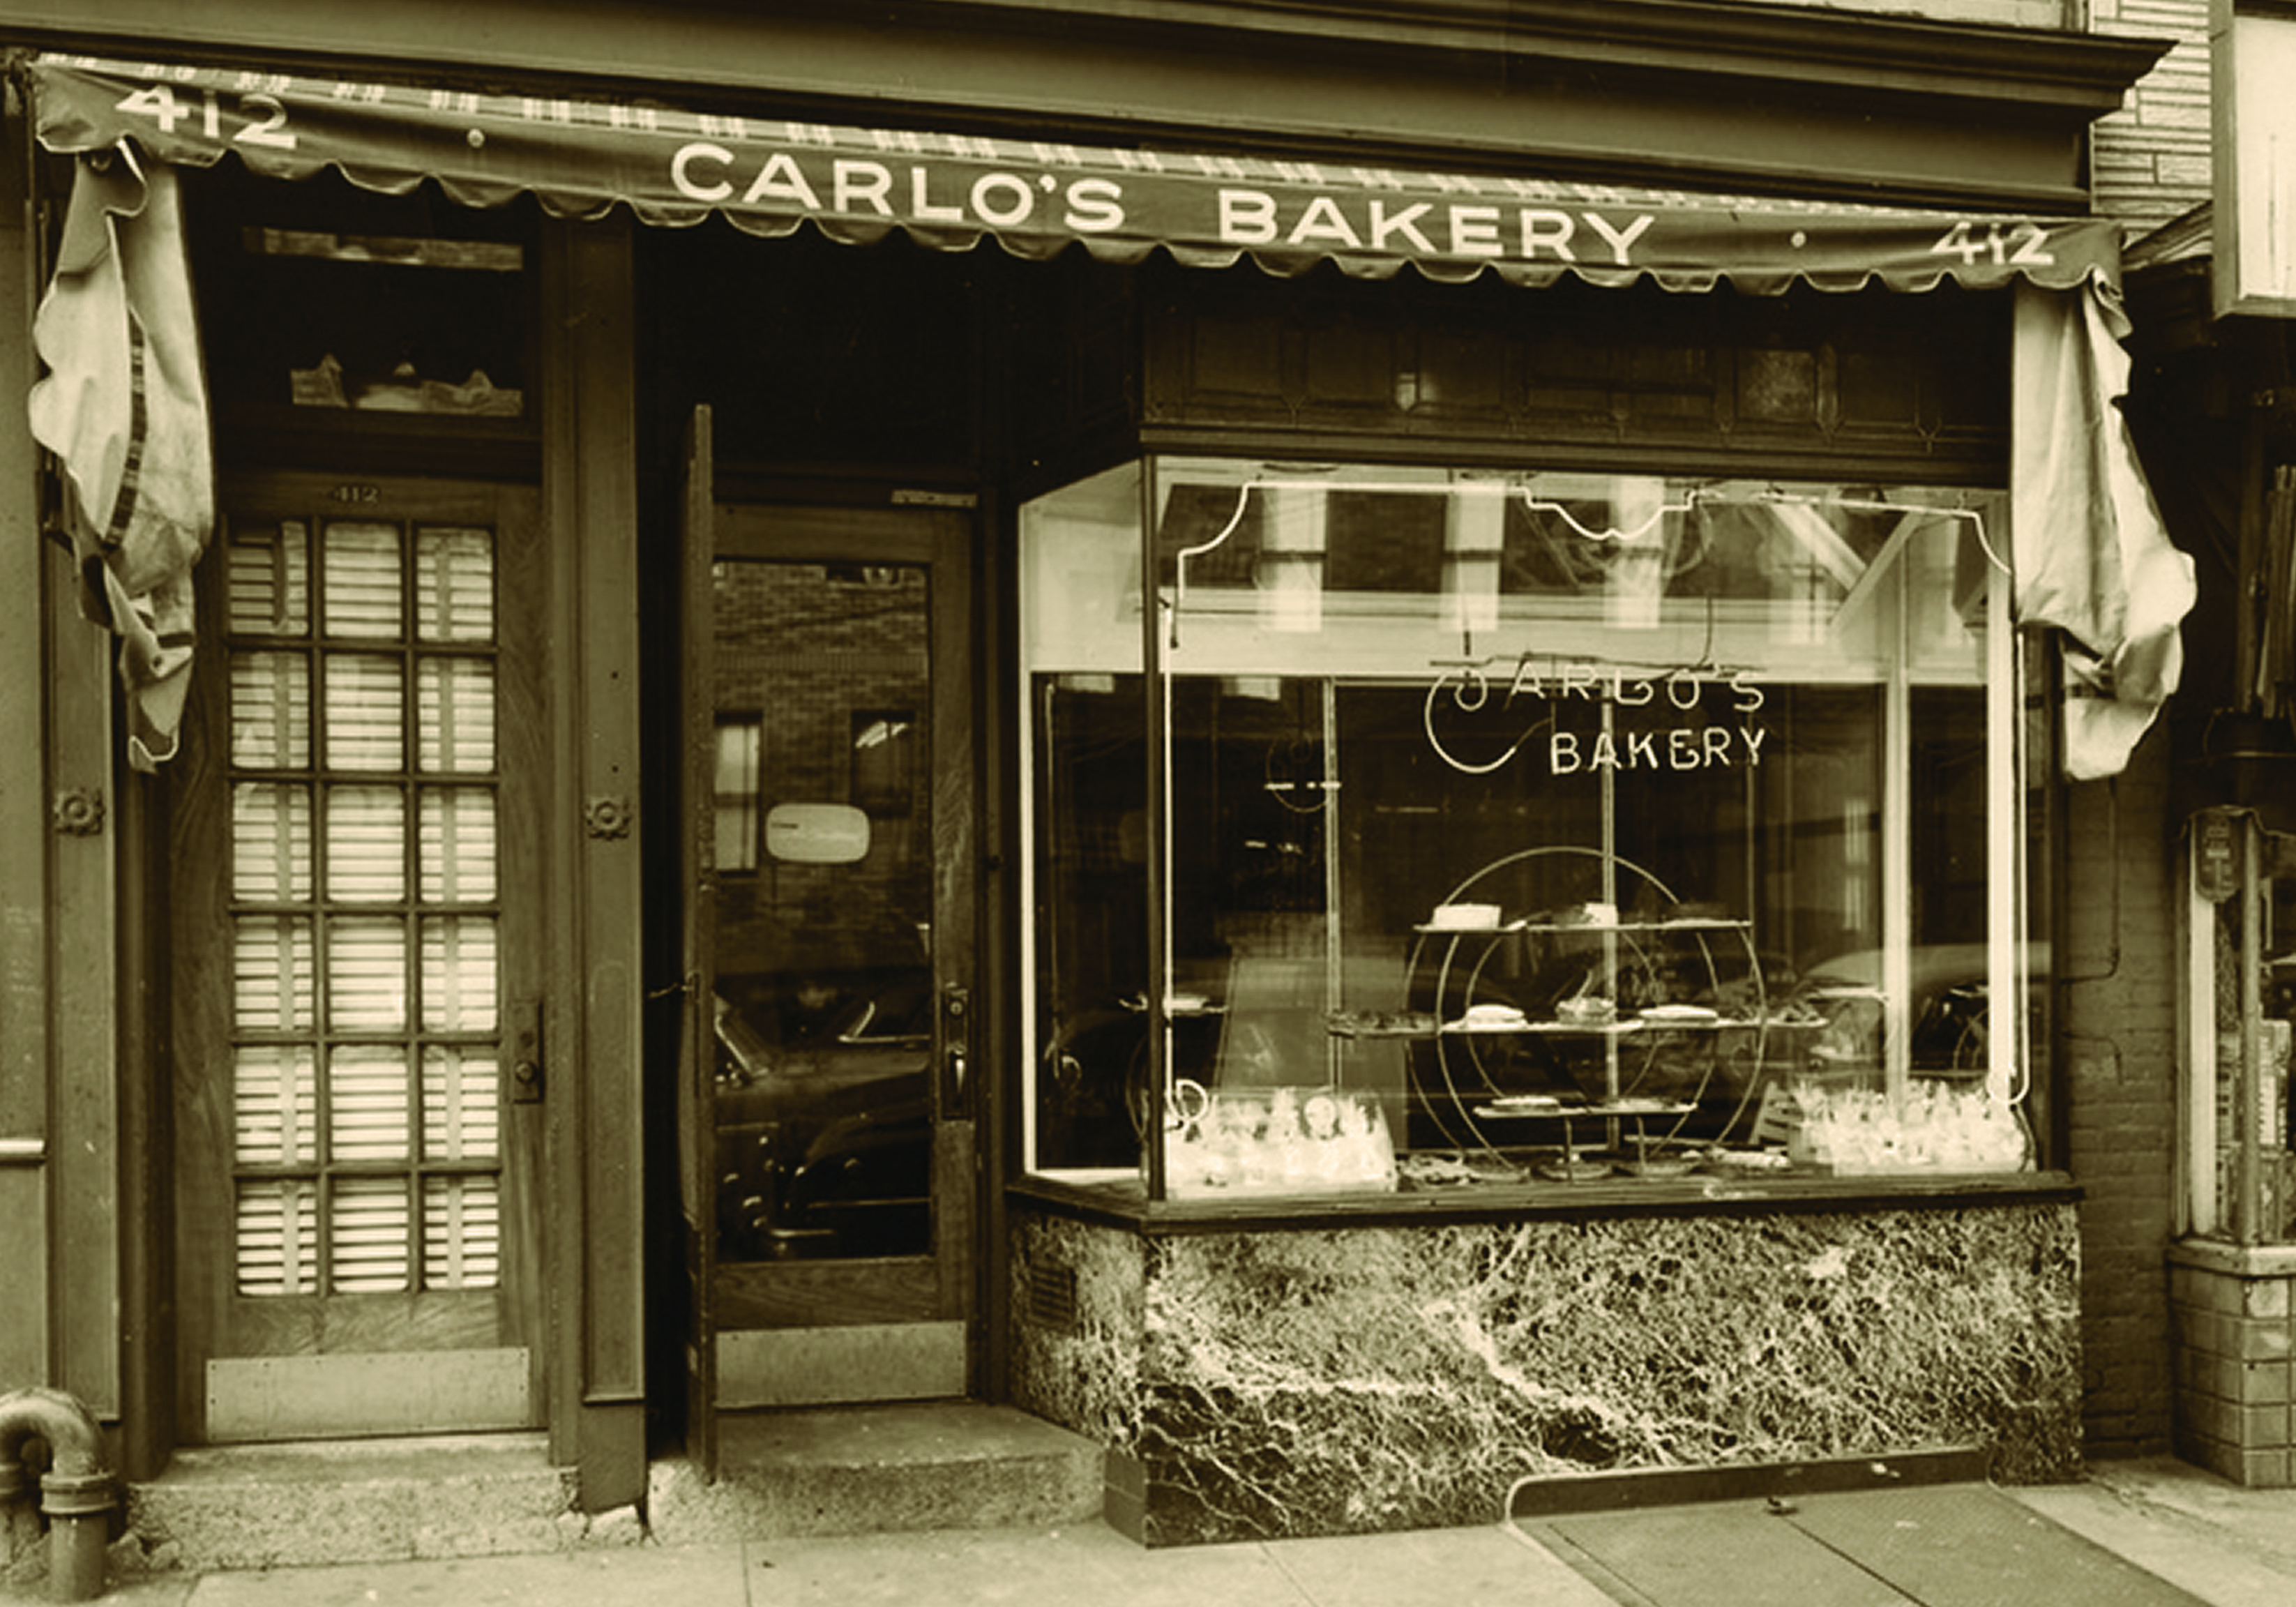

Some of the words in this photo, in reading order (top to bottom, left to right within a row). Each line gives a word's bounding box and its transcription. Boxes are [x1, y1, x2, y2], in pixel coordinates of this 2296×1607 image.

[116, 86, 297, 149] 412
[671, 144, 1125, 231] CARLO'S
[1218, 189, 1655, 265] BAKERY
[1931, 221, 2054, 266] 412
[1551, 727, 1765, 774] BAKERY
